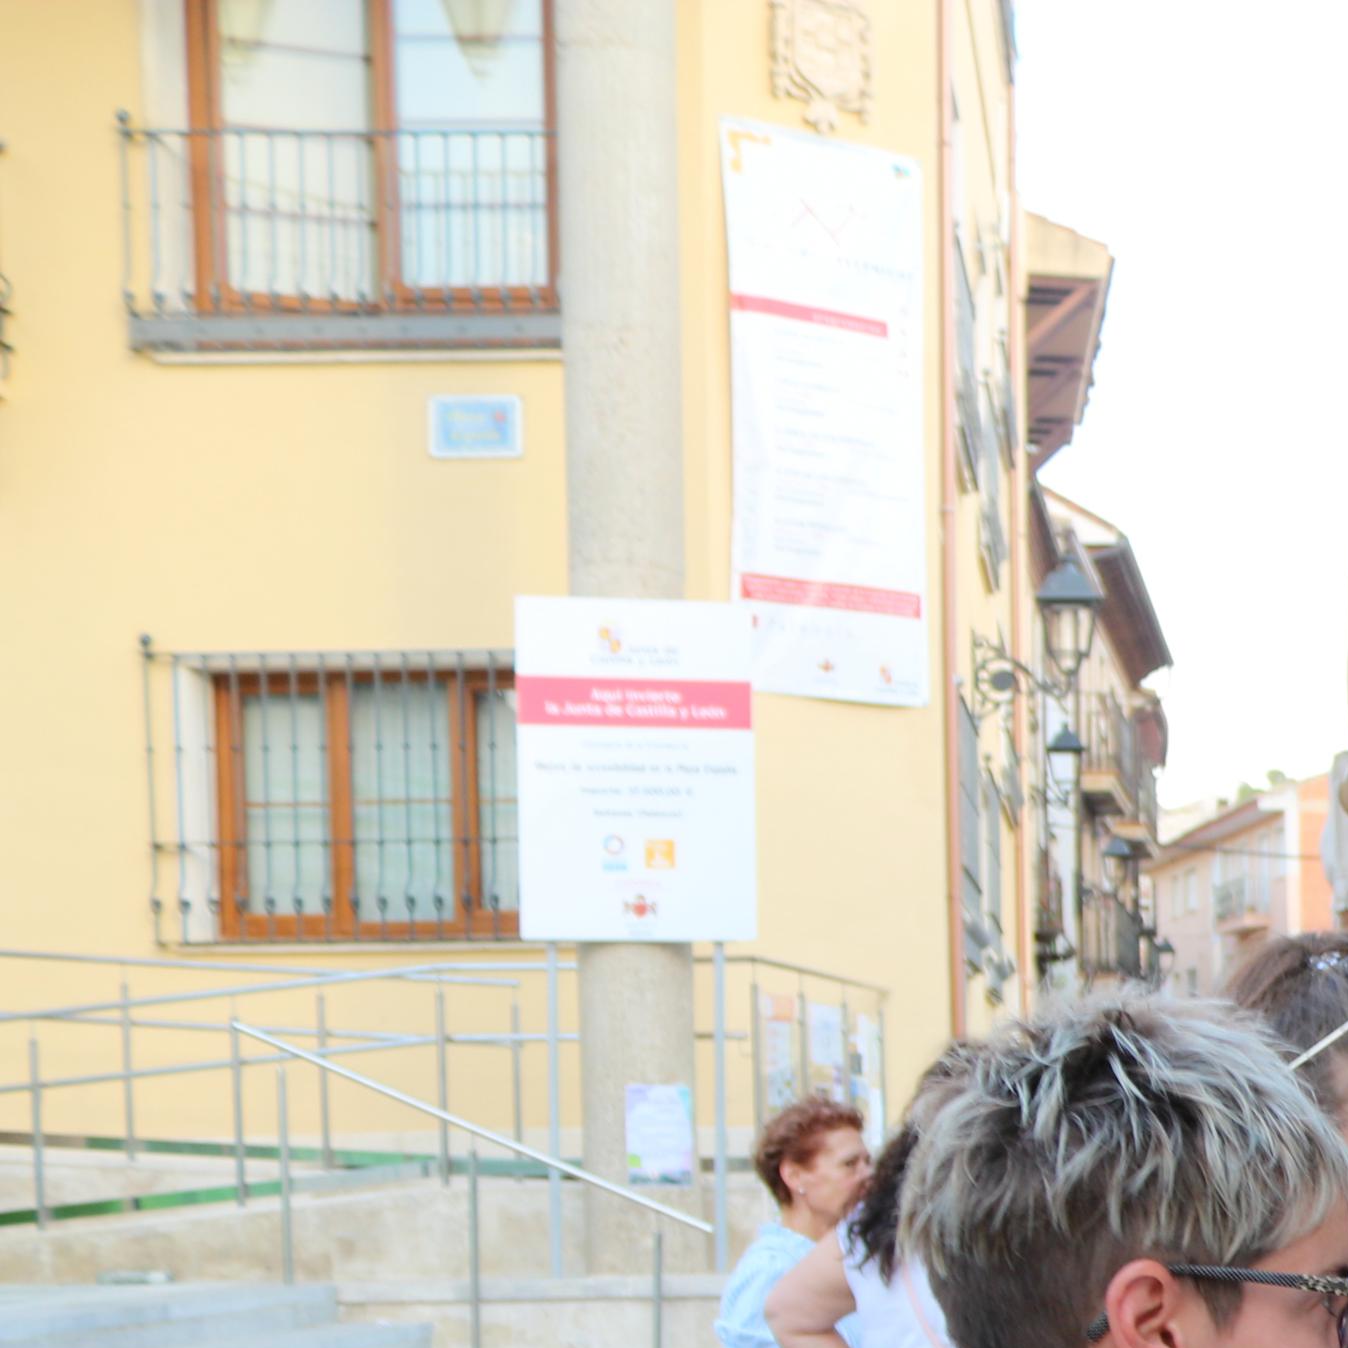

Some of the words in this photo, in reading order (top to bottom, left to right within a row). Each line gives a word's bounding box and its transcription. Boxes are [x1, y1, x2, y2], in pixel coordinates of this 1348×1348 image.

[590, 687, 622, 702] Aquí
[562, 702, 602, 718] Junta
[605, 702, 623, 718] de
[627, 704, 676, 720] Castilla
